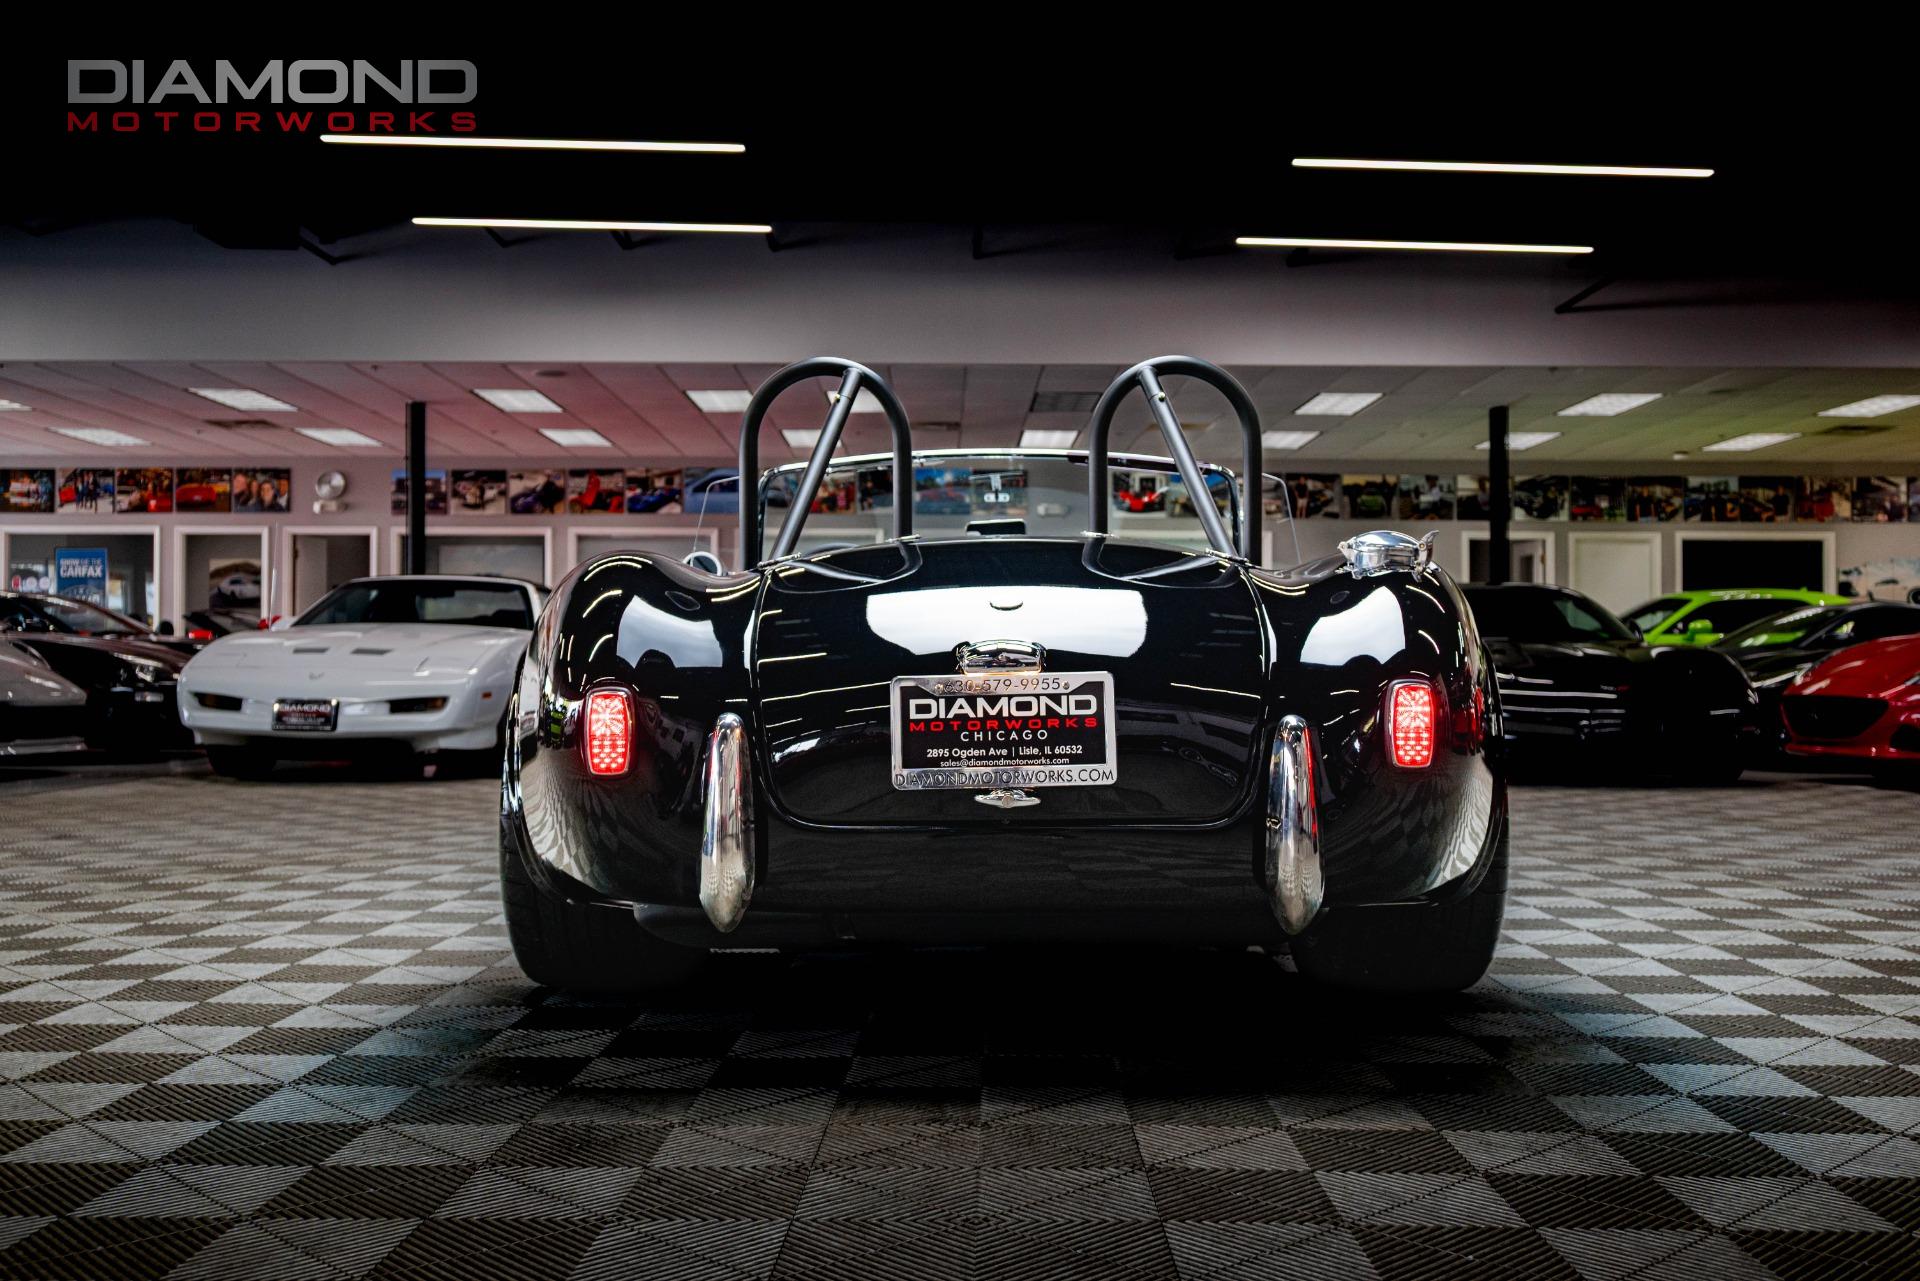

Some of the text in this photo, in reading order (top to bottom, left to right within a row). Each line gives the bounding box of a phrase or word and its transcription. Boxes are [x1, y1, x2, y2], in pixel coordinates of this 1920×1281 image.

[60, 565, 103, 578] CARFAX
[944, 677, 1061, 693] 630-579-9955
[909, 694, 1098, 720] DIAMOND
[909, 717, 1098, 732] MOTORWORKS
[960, 729, 1049, 742] CHICAGO
[926, 748, 950, 758] 2895
[951, 747, 986, 759] Ogden
[988, 747, 1008, 757] Ave
[1018, 746, 1042, 756] Lisle,
[1044, 745, 1052, 755] IL
[1054, 745, 1083, 755] 60532
[940, 757, 1070, 768] sales@diamondmotorworks.com
[894, 768, 1114, 787] DIAMONDMOTORWORKS.COM
